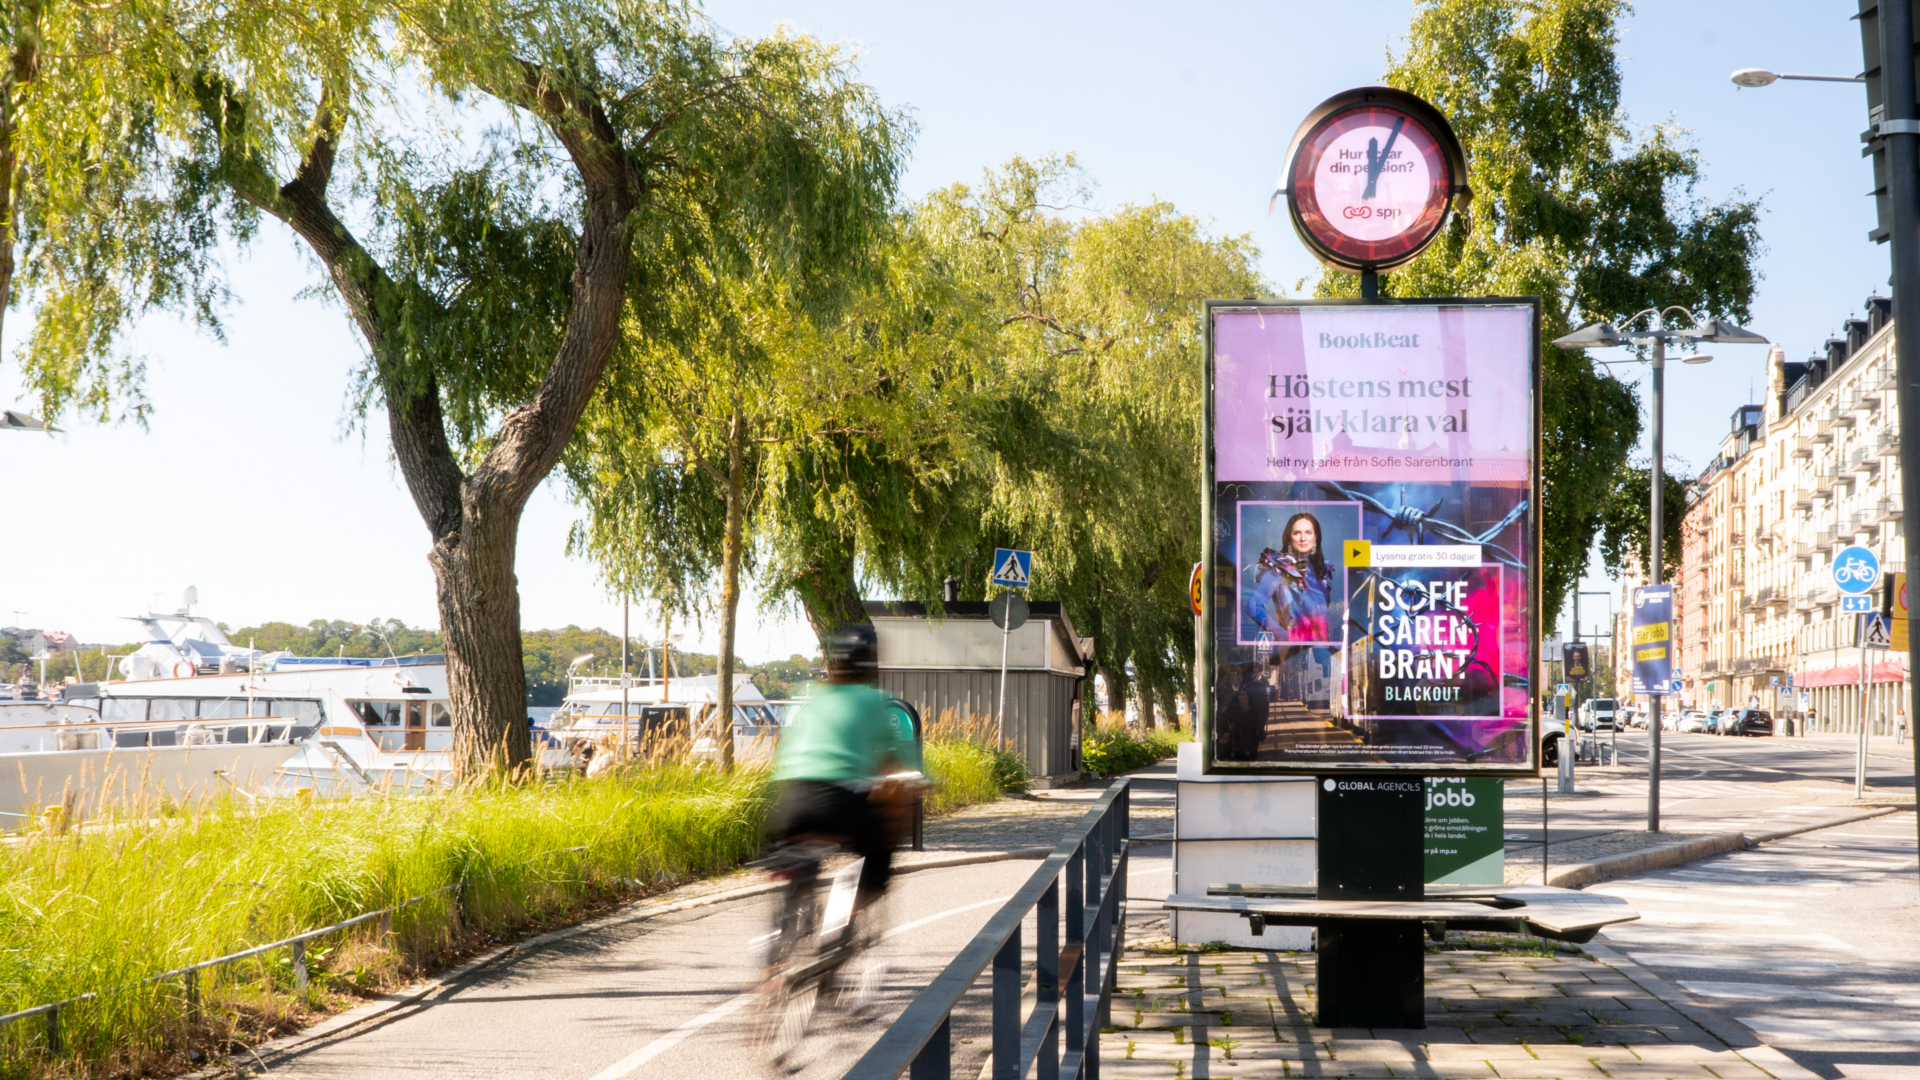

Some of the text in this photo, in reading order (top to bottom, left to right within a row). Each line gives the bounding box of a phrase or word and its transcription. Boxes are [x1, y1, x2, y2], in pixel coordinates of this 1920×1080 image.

[1339, 149, 1363, 160] Hur
[1330, 161, 1415, 176] din pesion?
[1376, 208, 1402, 220] spp
[1318, 331, 1420, 349] BookBeat
[1268, 374, 1473, 398] Höstens mest
[1271, 407, 1468, 440] självklara val
[1266, 455, 1474, 469] Helt ny serie från Sofie Sarenbrant
[1375, 551, 1477, 562] Lyssna gratis 30 dagar
[1378, 579, 1469, 612] SOFIE
[1378, 614, 1480, 646] SAREN-
[1636, 625, 1665, 641] Fler jobb
[1379, 649, 1471, 680] BRANT
[1385, 686, 1461, 702] BLACKOUT
[1338, 781, 1375, 791] GLOBAL
[1377, 782, 1421, 792] AGENCIES
[1425, 787, 1476, 811] jobb
[1448, 817, 1470, 825] jobben.
[1446, 825, 1488, 833] omställningen
[1430, 847, 1439, 855] på
